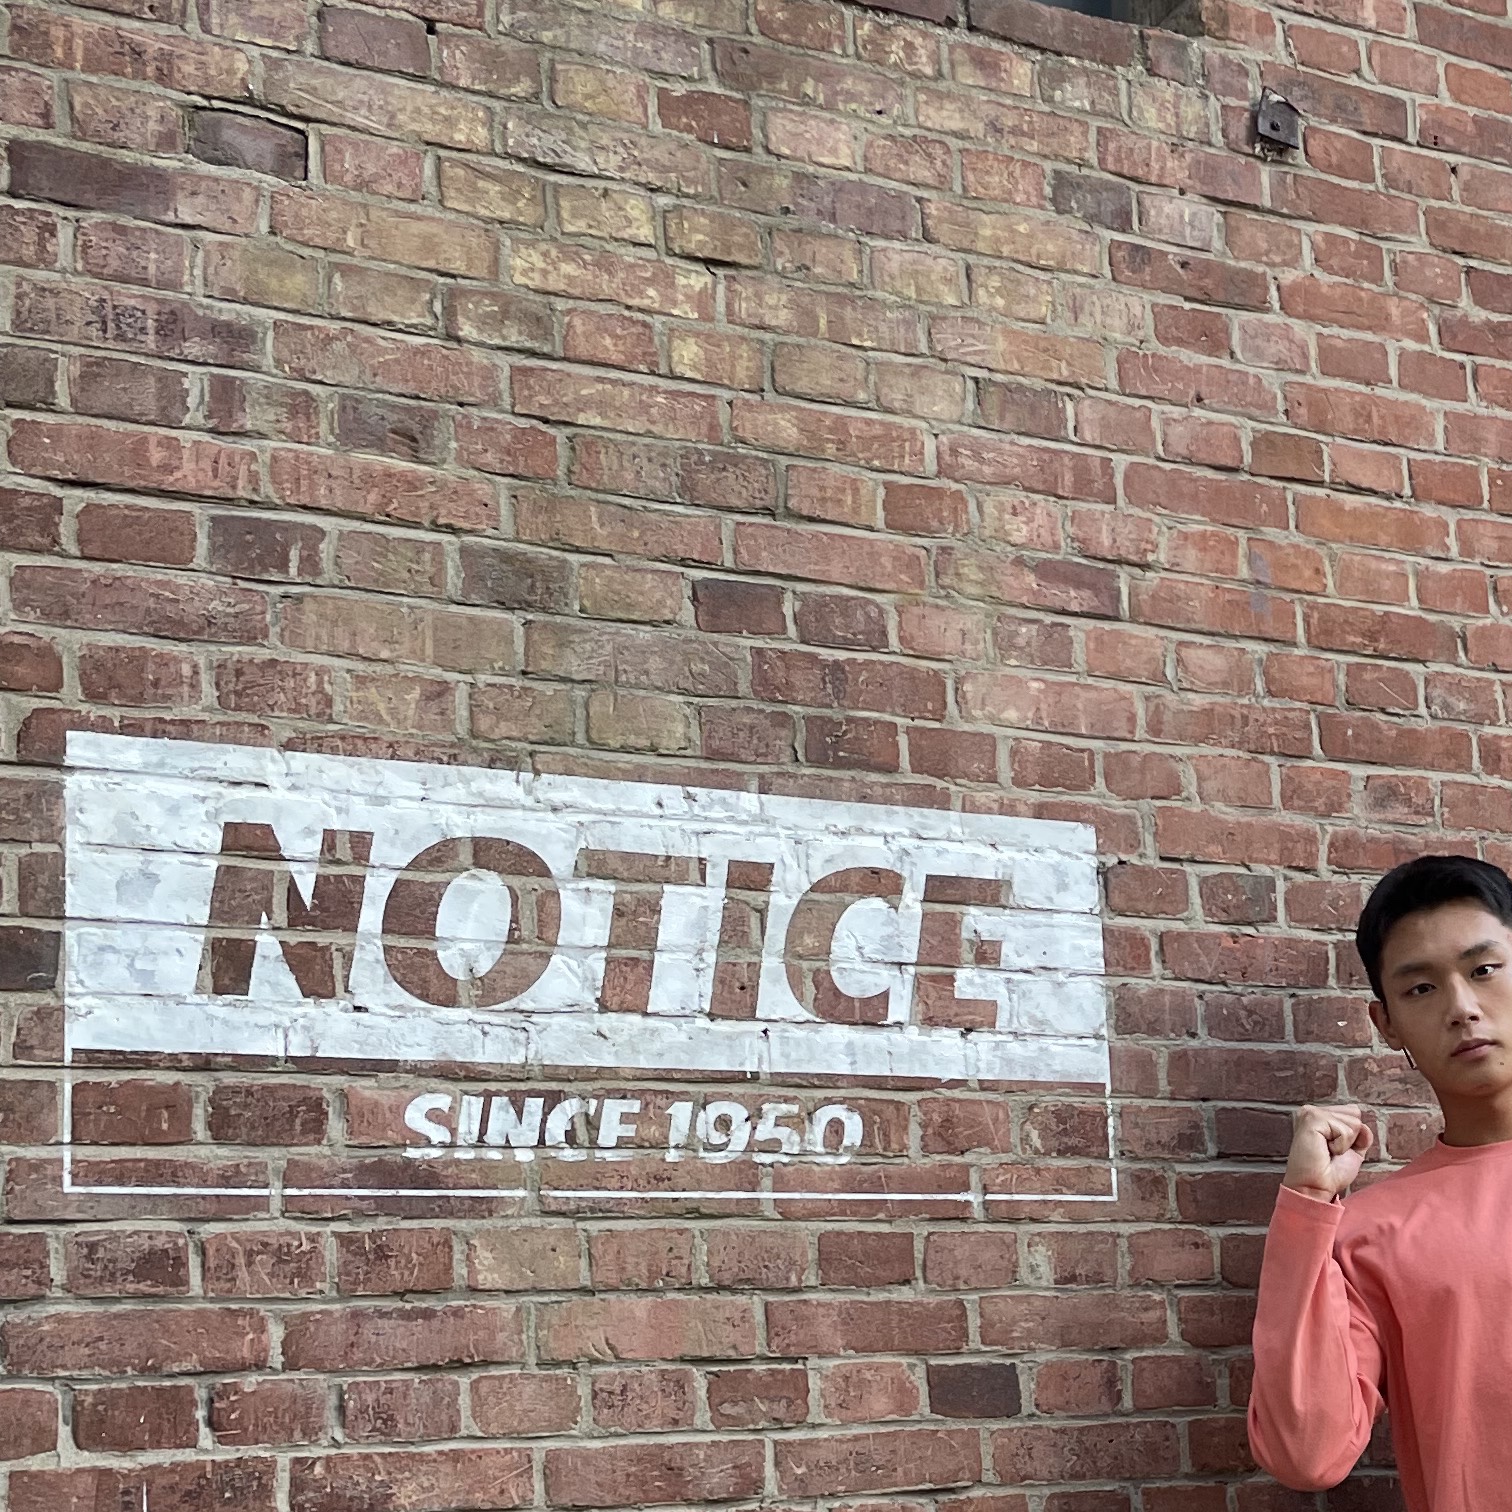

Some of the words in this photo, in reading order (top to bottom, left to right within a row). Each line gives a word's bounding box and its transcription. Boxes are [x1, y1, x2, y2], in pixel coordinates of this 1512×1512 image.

[202, 820, 1014, 1030] NOTICE
[401, 1092, 642, 1163] SINCE
[664, 1100, 864, 1165] 1950
